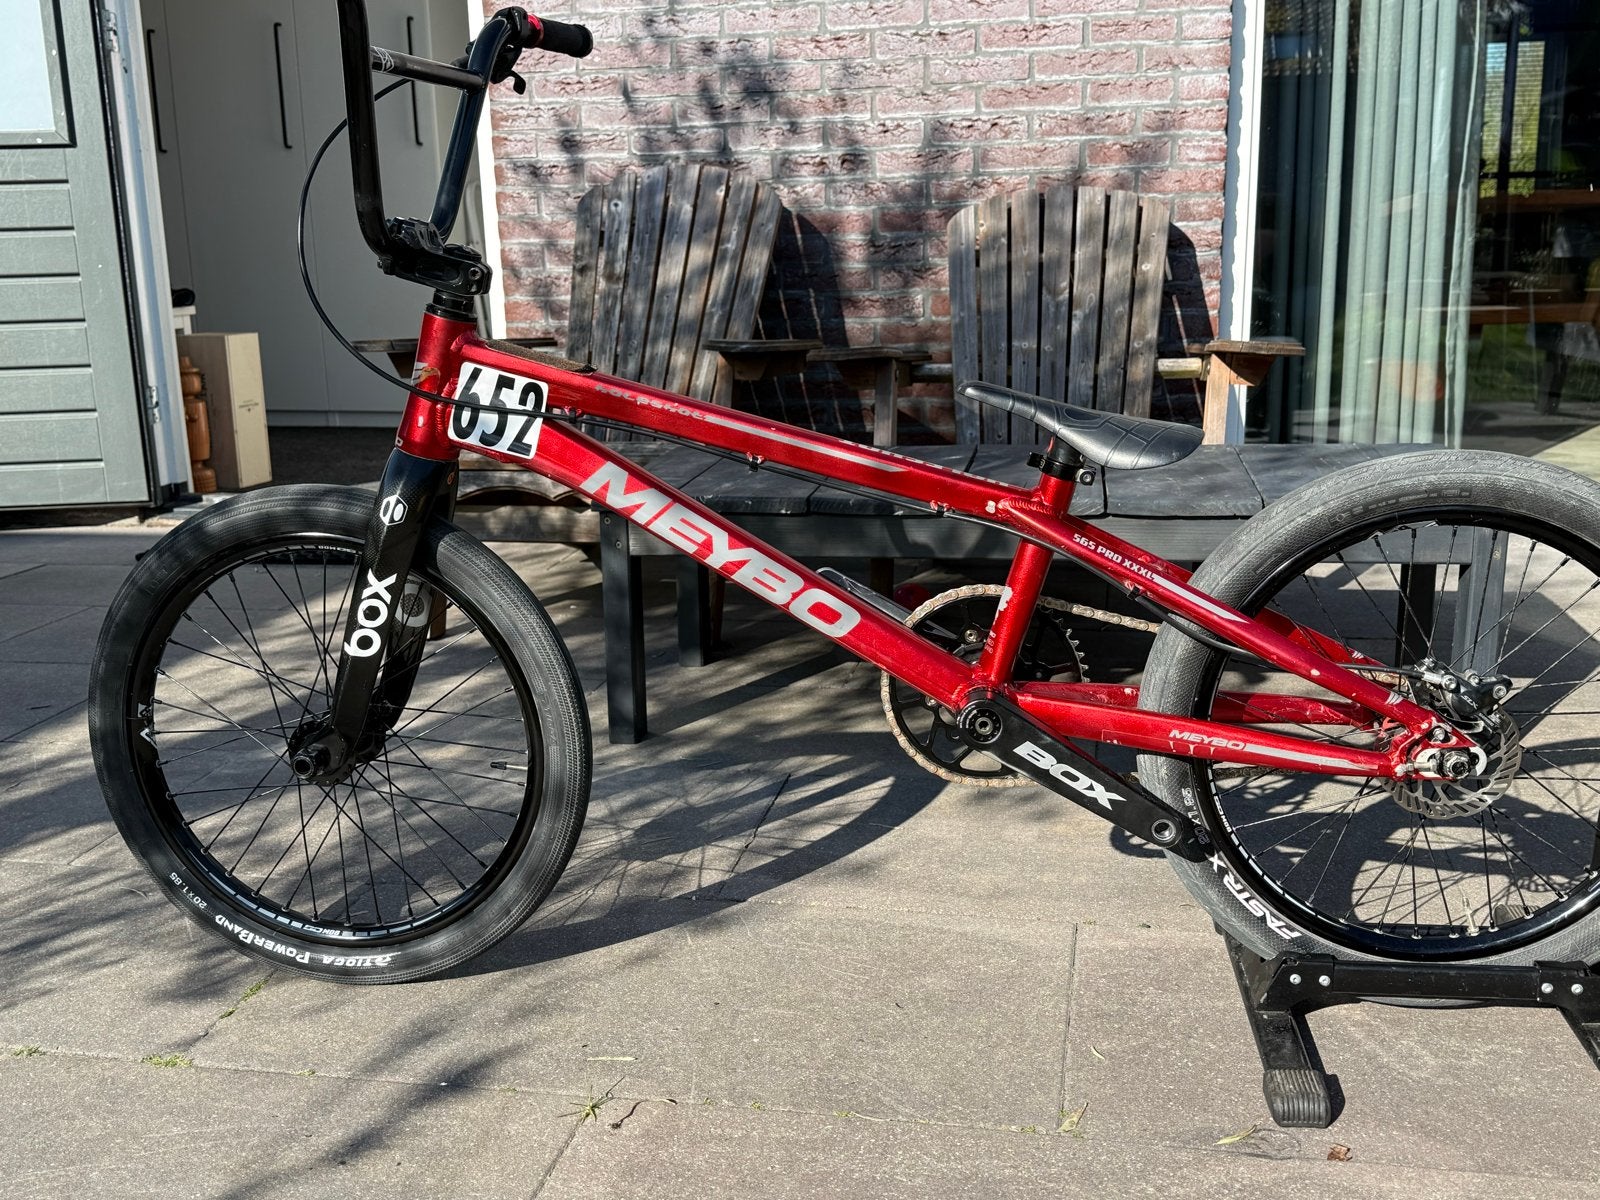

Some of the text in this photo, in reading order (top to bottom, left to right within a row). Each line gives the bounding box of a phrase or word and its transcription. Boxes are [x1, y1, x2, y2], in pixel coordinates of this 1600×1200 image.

[453, 366, 544, 456] 652
[580, 461, 861, 638] MEYBO
[1097, 546, 1121, 564] PRO
[1122, 559, 1154, 581] XXXL
[1461, 694, 1479, 710] SLX
[1169, 730, 1246, 750] MEYBO
[1013, 741, 1127, 810] BOX
[1204, 850, 1302, 940] FASTR X
[321, 954, 373, 967] TIOGA
